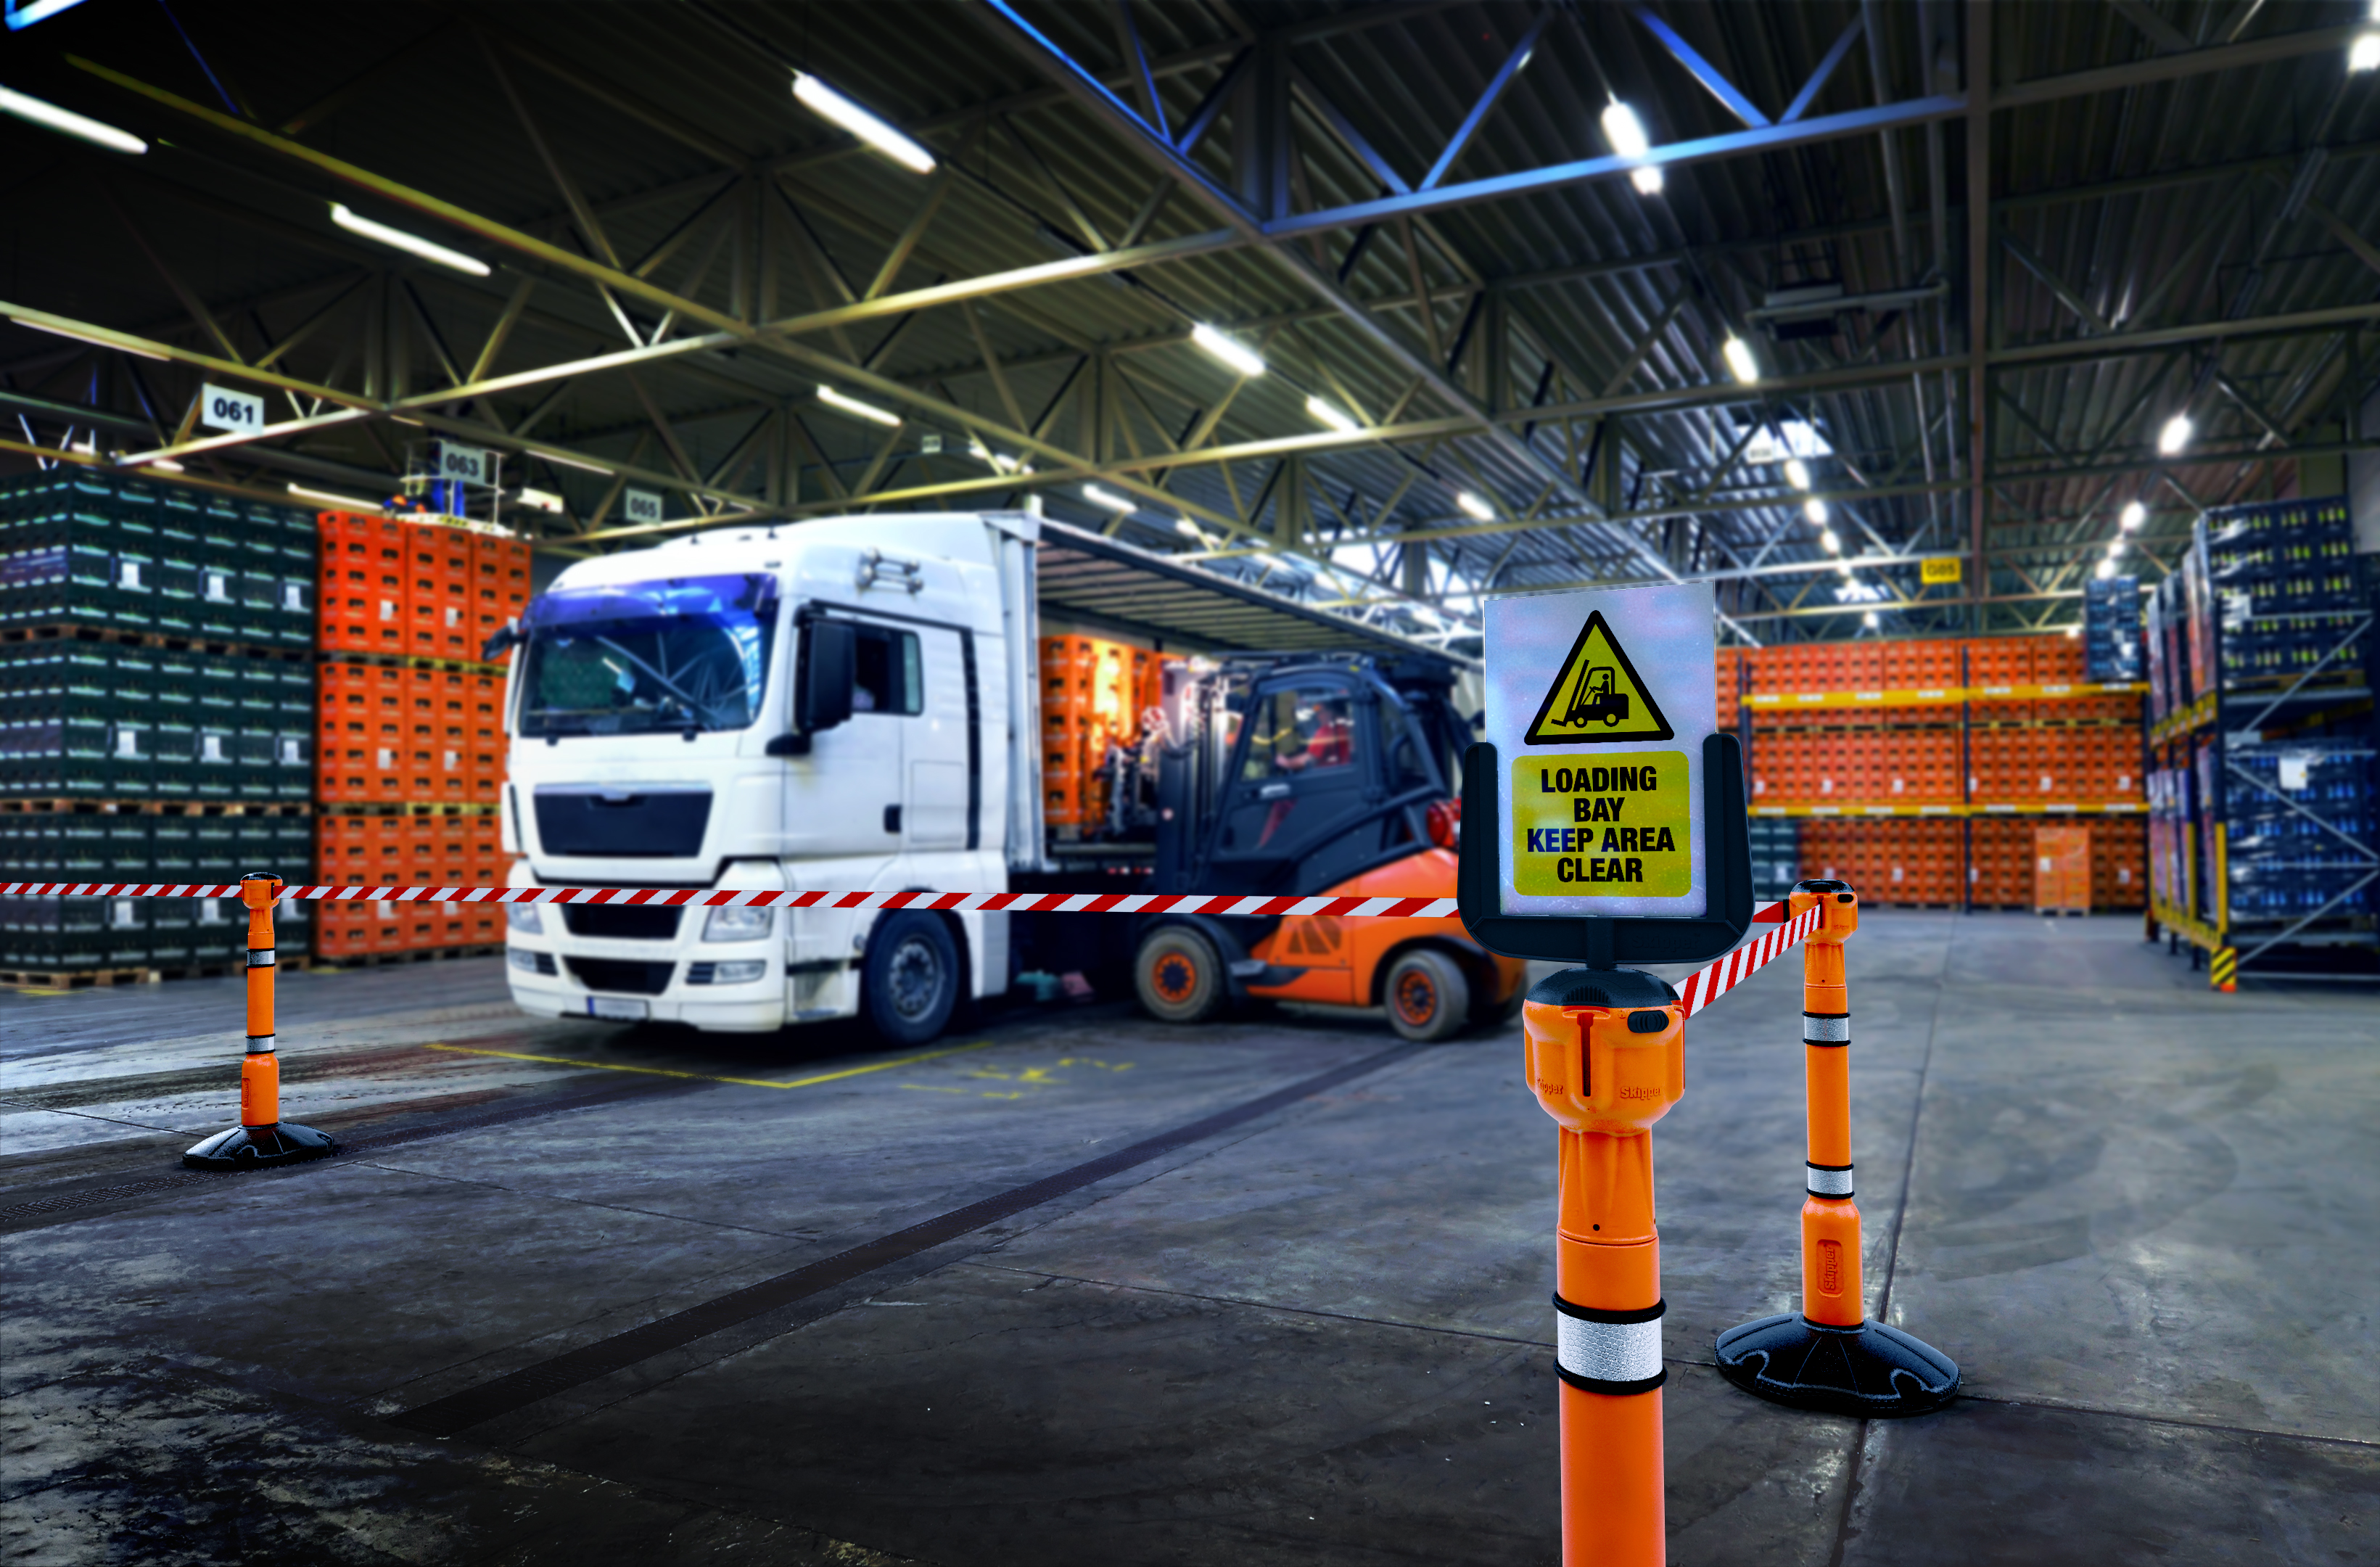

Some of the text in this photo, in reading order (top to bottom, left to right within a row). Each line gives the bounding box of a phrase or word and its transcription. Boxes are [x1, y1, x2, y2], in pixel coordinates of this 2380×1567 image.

[213, 397, 253, 425] 061
[446, 453, 479, 477] 063
[1541, 765, 1657, 793] LOADING
[1573, 797, 1626, 822] BAY
[1527, 826, 1676, 852] KEEP AREA
[1557, 857, 1644, 883] CLEAR
[1824, 1246, 1837, 1291] Skipper
